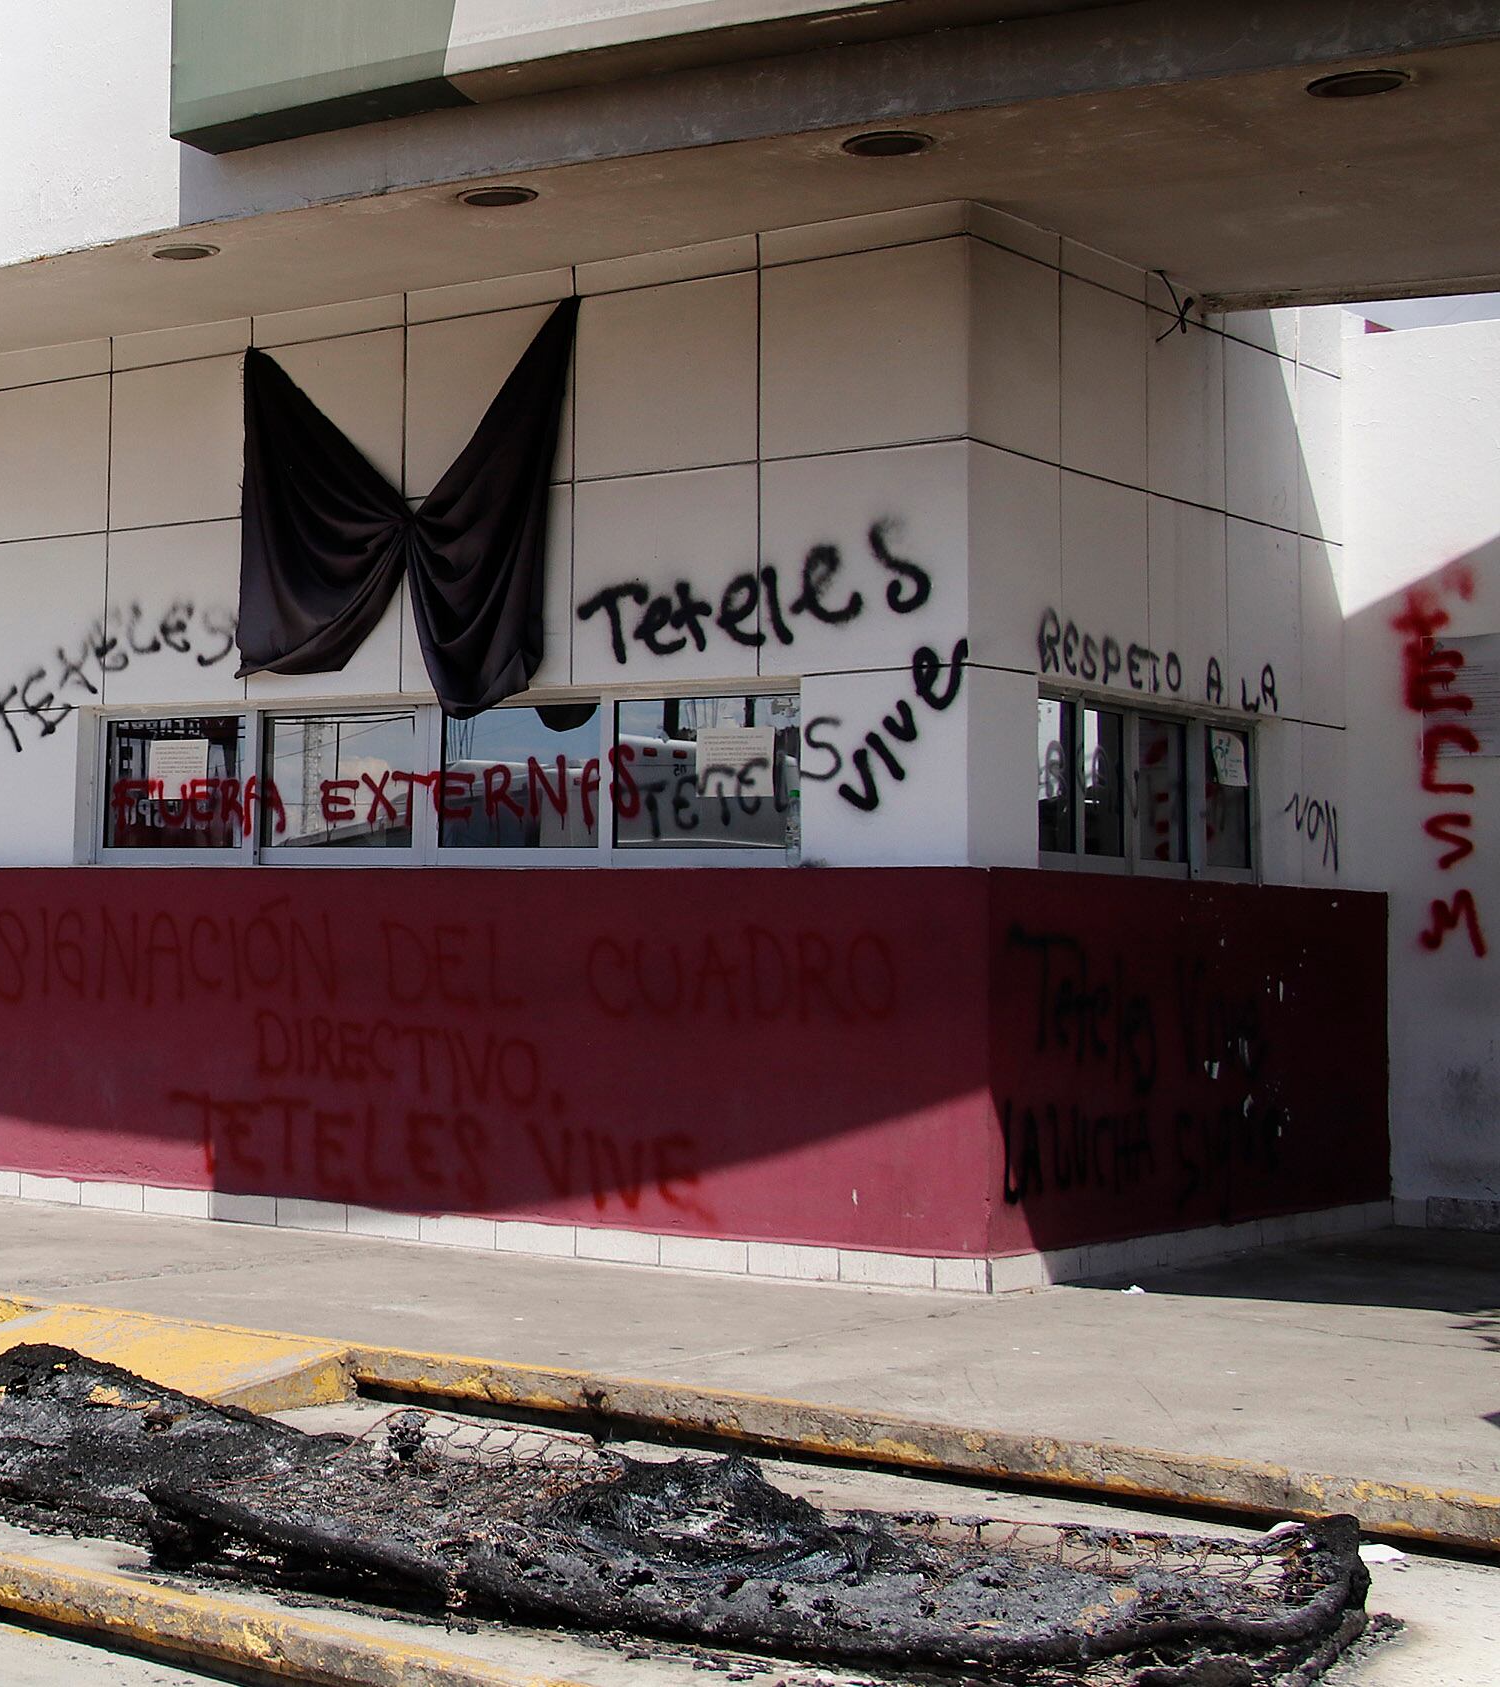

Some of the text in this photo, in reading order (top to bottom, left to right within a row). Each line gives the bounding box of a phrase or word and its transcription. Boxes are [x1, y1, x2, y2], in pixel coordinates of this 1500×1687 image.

[1037, 605, 1182, 694] RESPETO
[1206, 655, 1223, 705] A
[111, 773, 285, 838] FUERA
[319, 742, 641, 832] EXTERNAS
[379, 916, 525, 1013] DEL
[584, 920, 900, 1023] CUADRO
